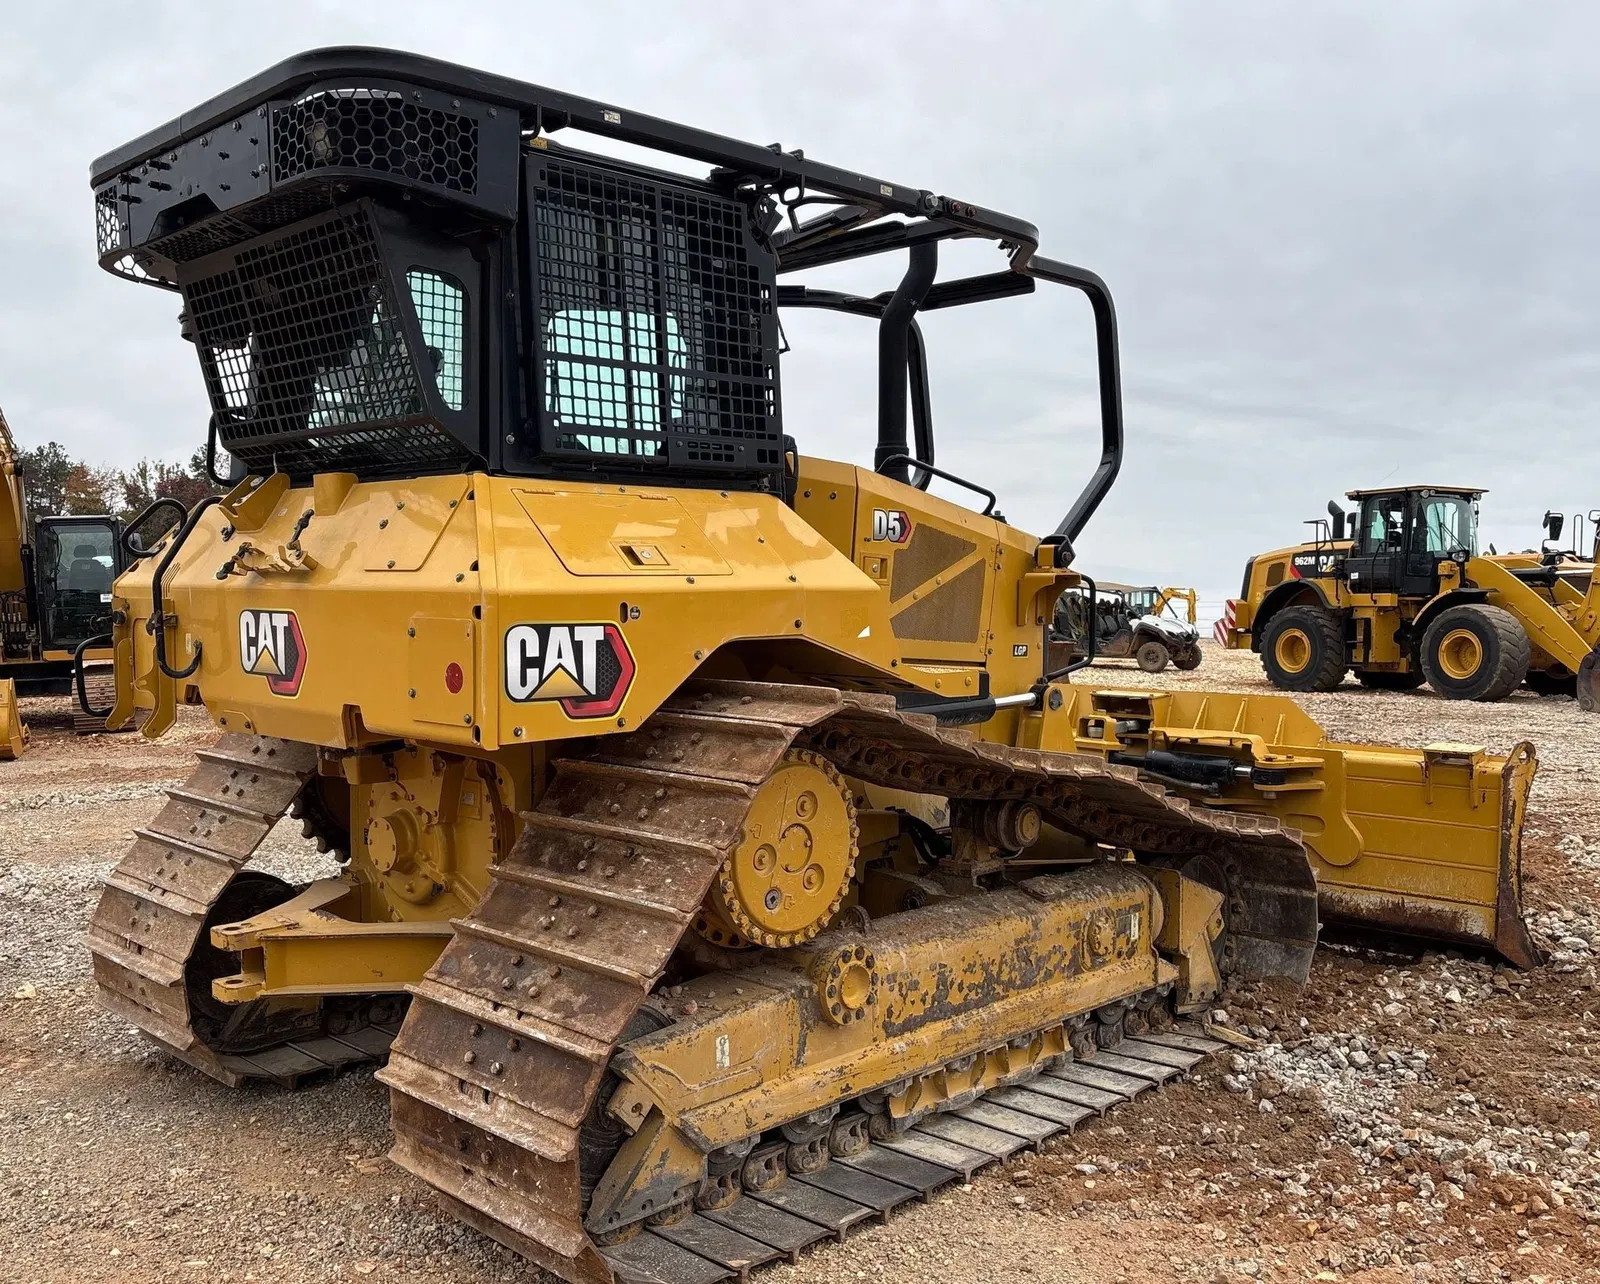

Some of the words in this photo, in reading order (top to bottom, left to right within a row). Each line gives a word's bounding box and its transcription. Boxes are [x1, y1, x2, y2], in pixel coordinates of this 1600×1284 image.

[873, 510, 901, 542] D5
[1294, 556, 1316, 566] 962M
[1317, 555, 1336, 573] CA
[240, 610, 289, 676] CAT
[1014, 645, 1027, 656] LGP
[506, 625, 605, 700] CAT
